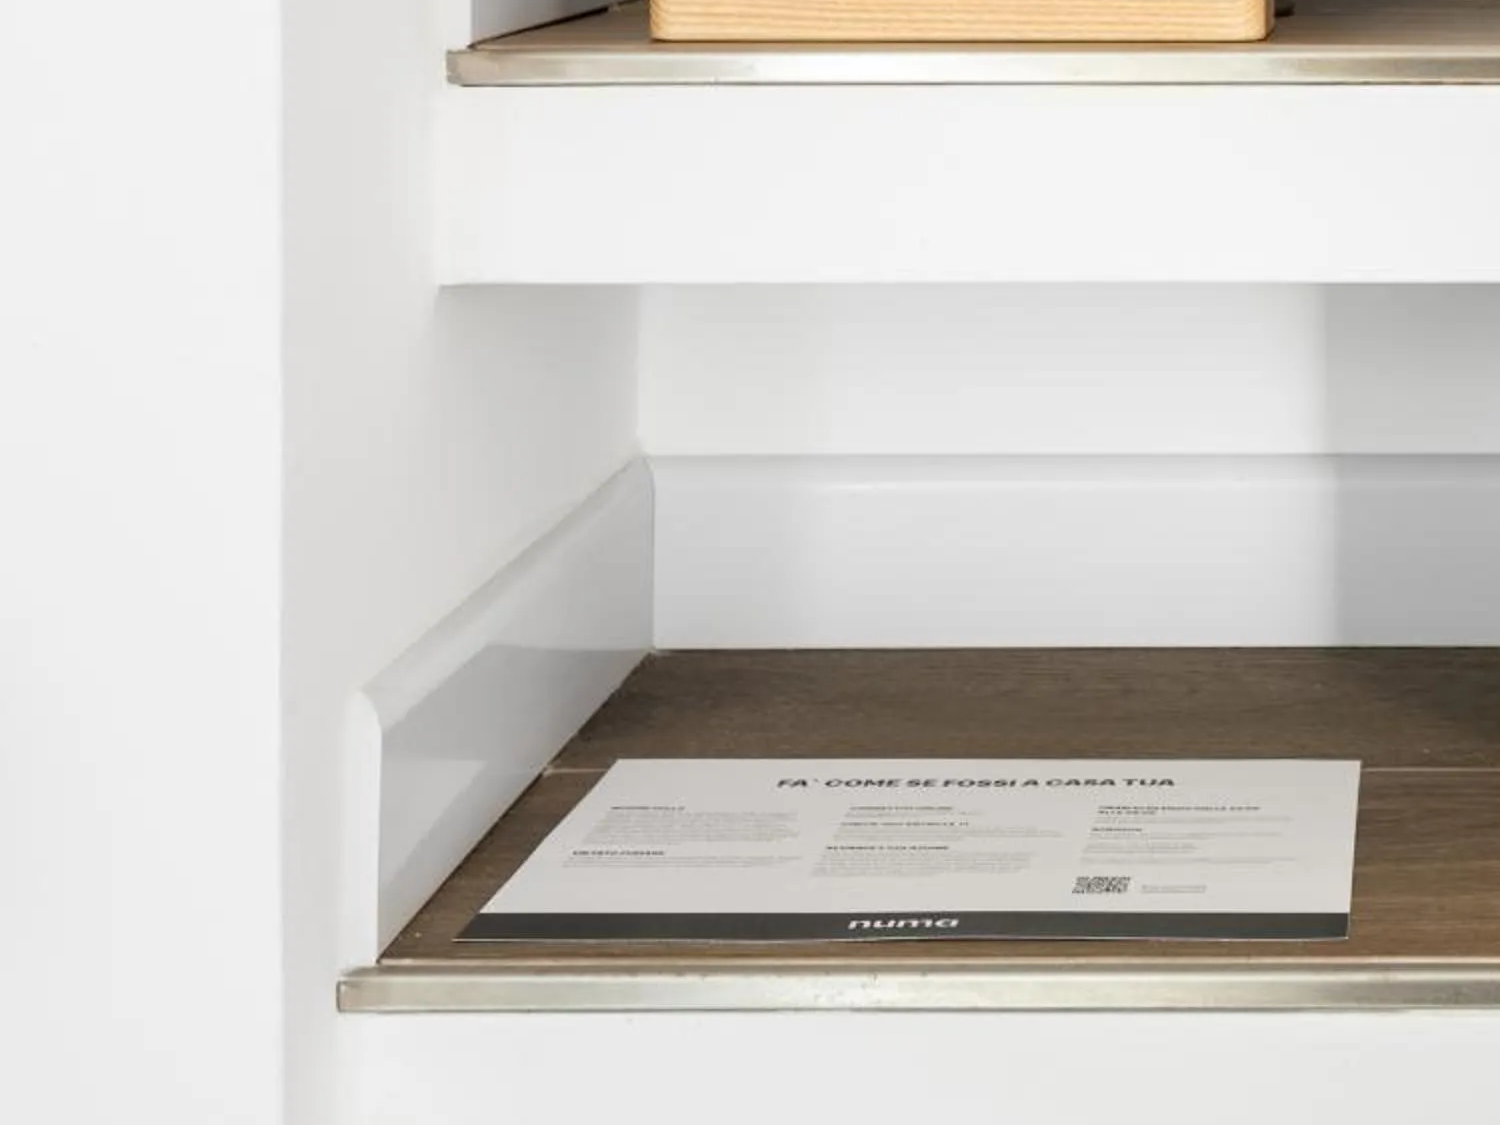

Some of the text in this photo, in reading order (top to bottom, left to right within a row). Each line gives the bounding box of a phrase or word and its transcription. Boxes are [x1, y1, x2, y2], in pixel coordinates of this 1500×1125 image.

[824, 778, 902, 788] COME
[906, 778, 938, 788] SE
[942, 778, 1017, 788] FOSSI
[1021, 778, 1040, 787] A
[1045, 778, 1116, 787] CASA
[1122, 778, 1175, 787] TUA
[847, 918, 959, 930] numa
